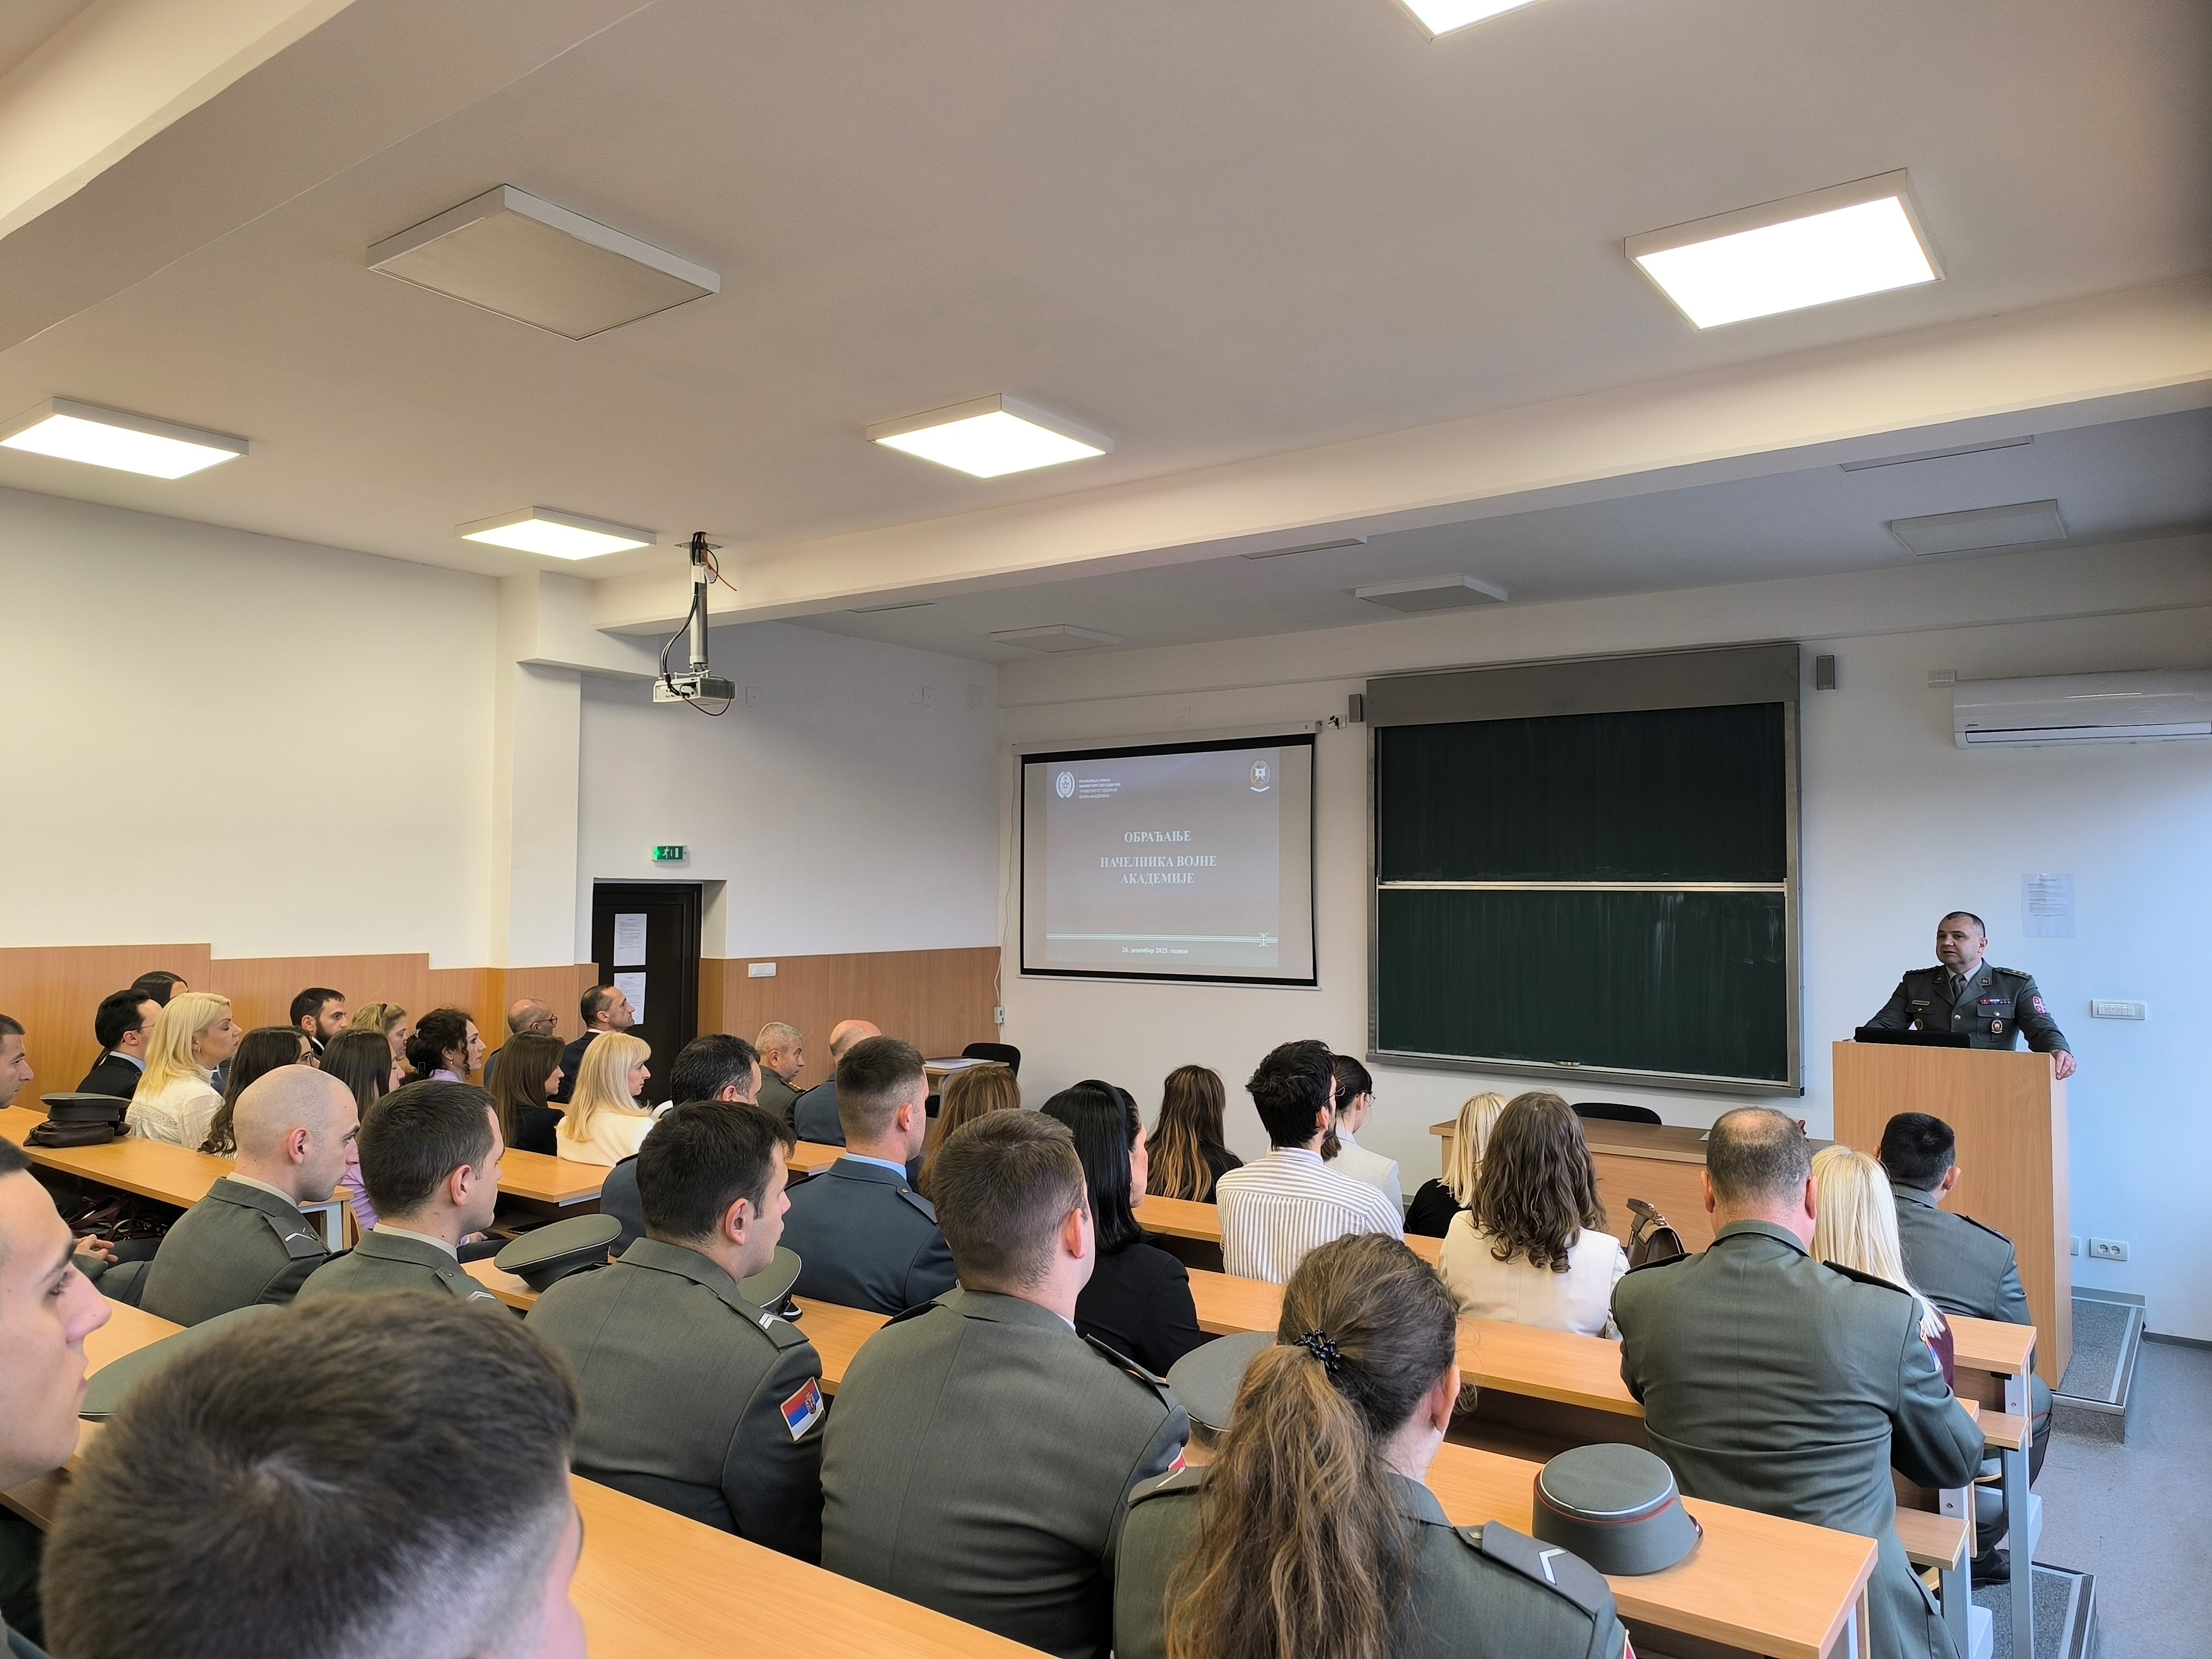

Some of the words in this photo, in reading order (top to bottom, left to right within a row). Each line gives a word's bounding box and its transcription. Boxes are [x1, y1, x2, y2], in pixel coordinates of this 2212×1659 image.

[1124, 831, 1192, 843] ОБРАЋАЊЕ
[1100, 856, 1174, 867] НАЧЕЛНИКА
[1176, 856, 1217, 867] ВОЈНЕ
[1121, 873, 1195, 885] АКАДЕМИЈЕ
